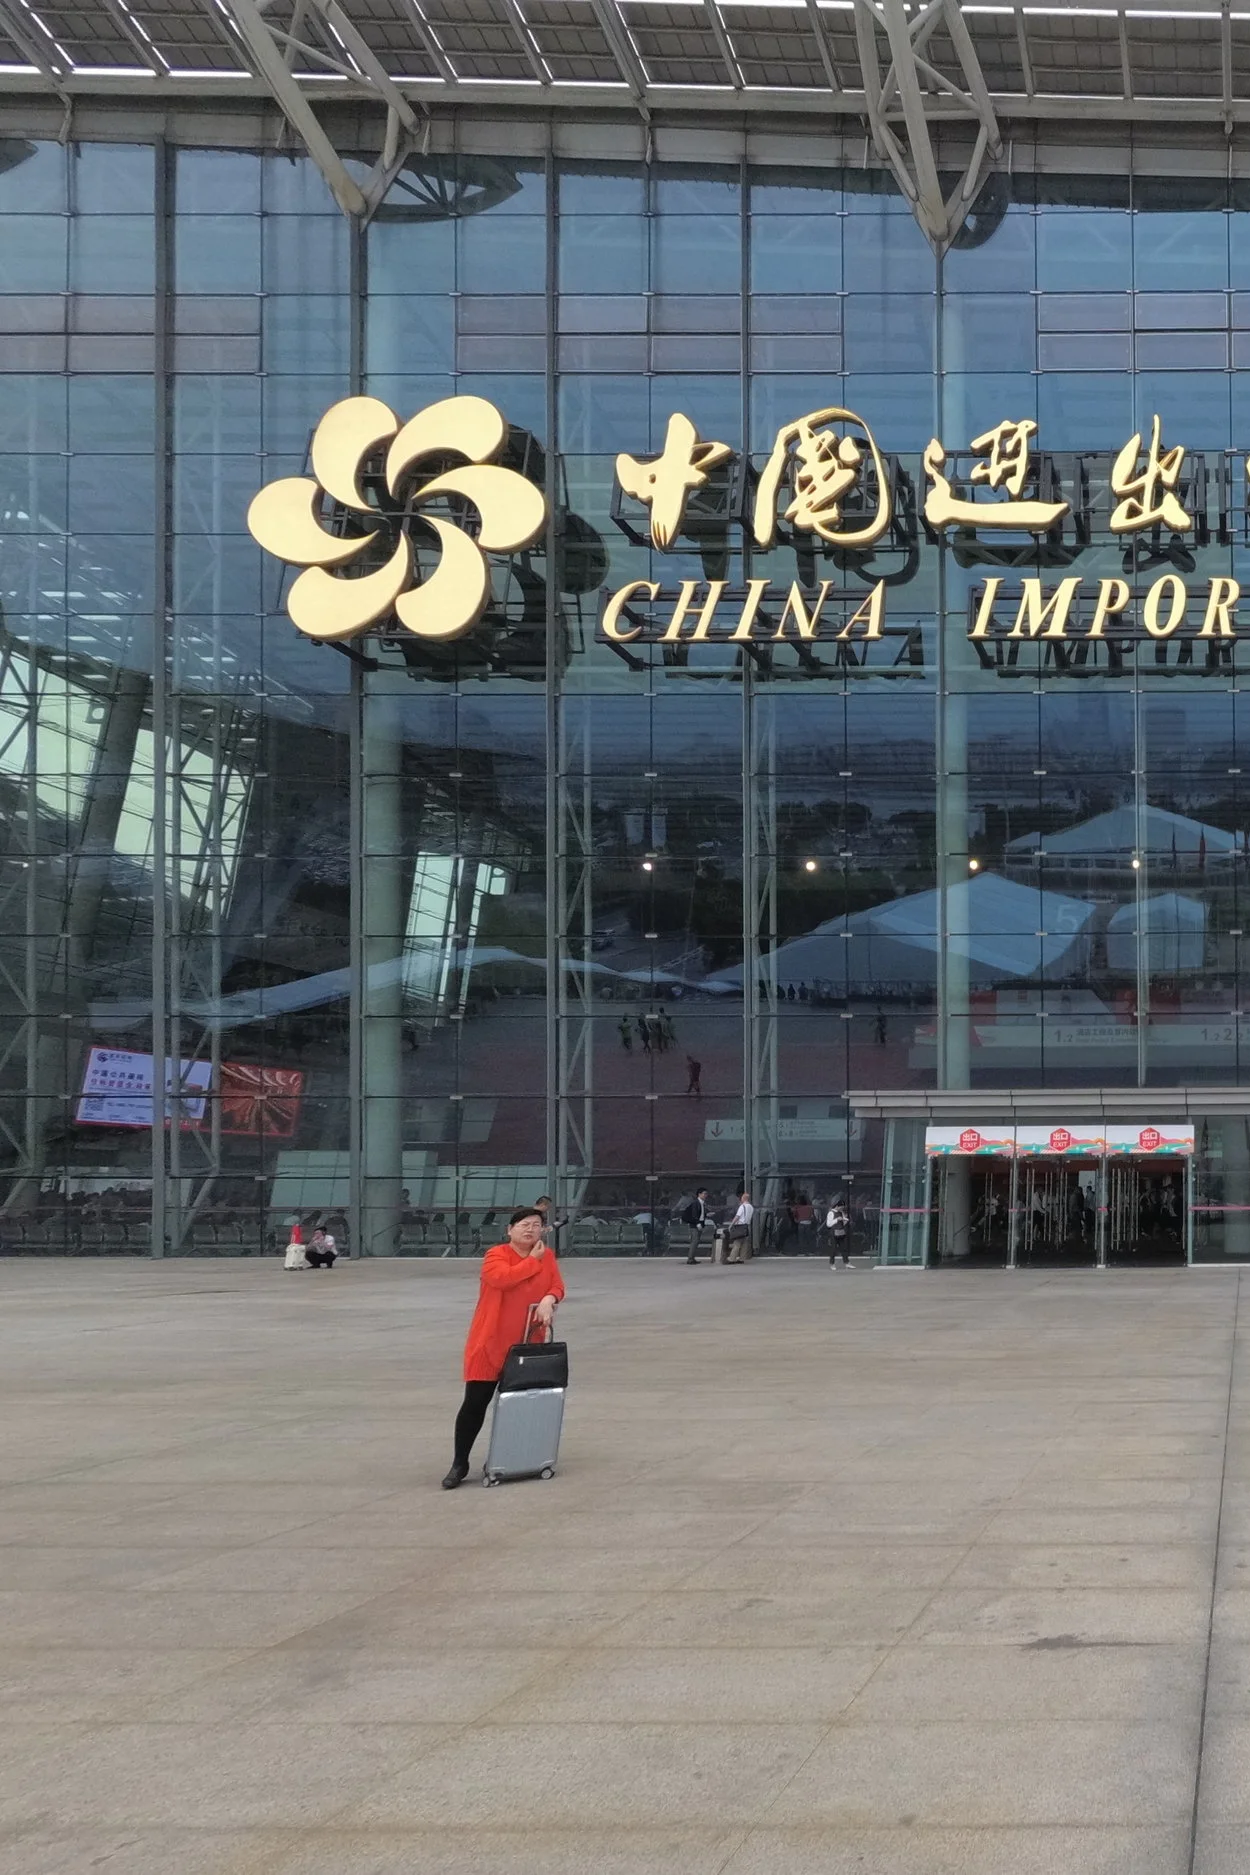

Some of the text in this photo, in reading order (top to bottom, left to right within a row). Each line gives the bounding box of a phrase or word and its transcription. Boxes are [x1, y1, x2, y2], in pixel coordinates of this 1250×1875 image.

[602, 578, 885, 642] CHINA
[962, 1132, 978, 1141] 出口
[1052, 1132, 1069, 1141] 出口
[1142, 1131, 1158, 1140] 出口
